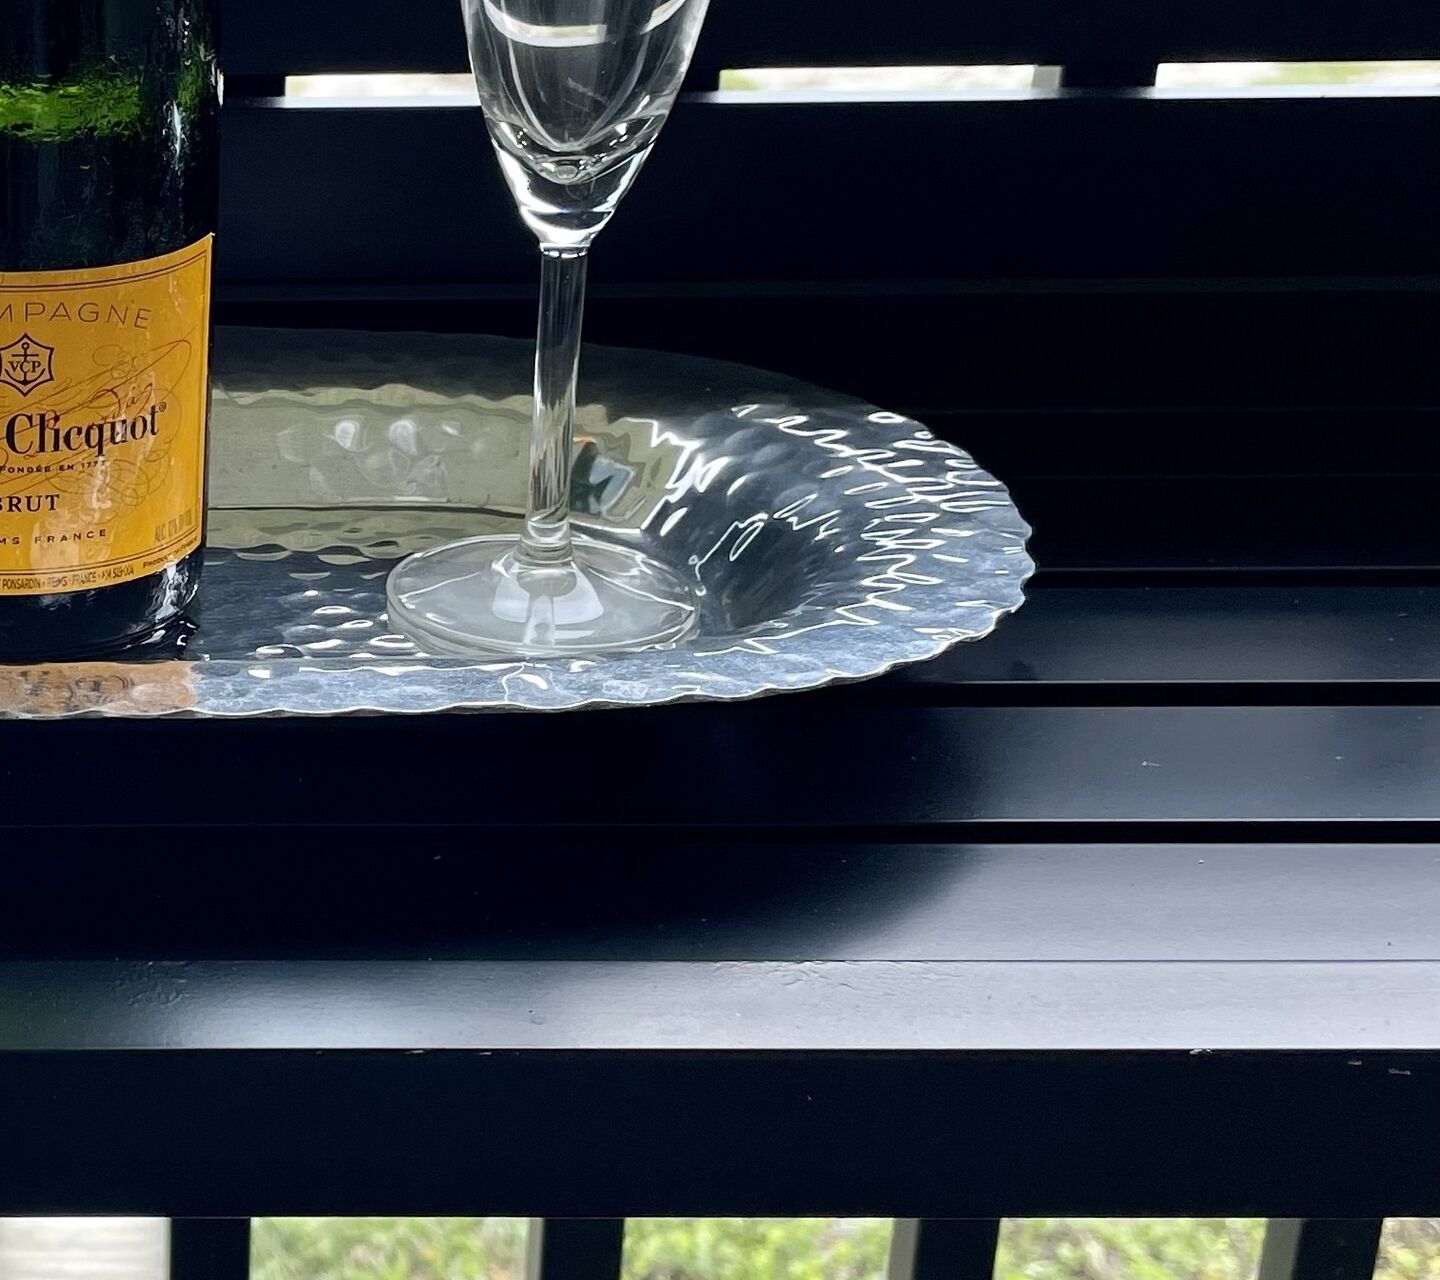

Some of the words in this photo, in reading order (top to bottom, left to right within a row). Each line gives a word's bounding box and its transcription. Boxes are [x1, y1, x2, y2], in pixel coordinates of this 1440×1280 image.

[7, 360, 43, 374] VCP
[59, 464, 75, 472] EN
[34, 528, 107, 545] FRANCE
[2, 576, 42, 590] PONSARDIN
